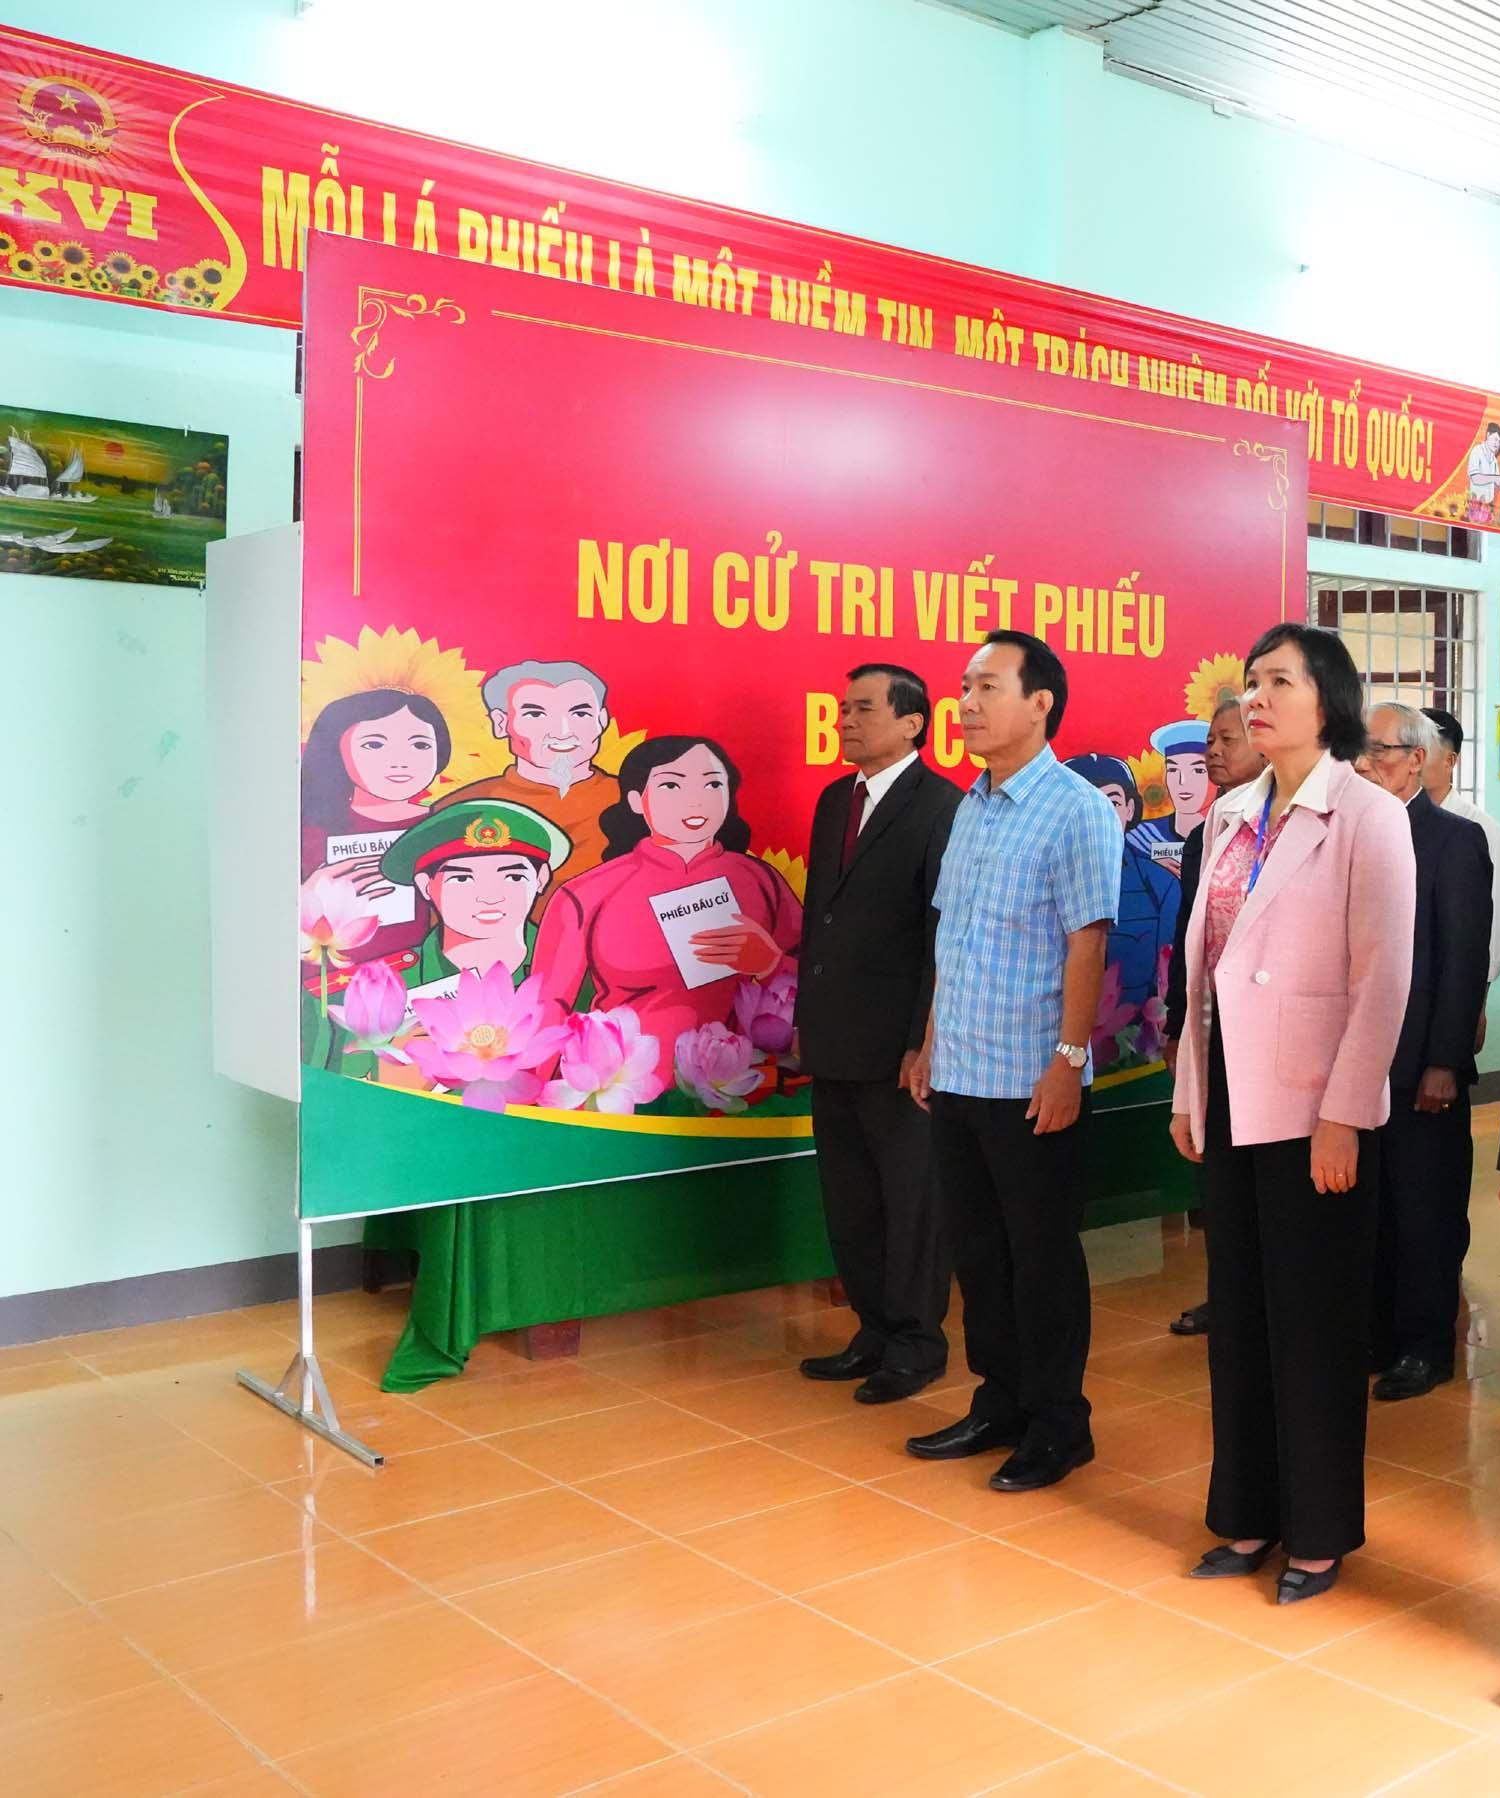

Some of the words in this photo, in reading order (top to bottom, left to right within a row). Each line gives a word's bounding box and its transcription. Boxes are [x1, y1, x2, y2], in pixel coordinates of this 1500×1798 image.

[1331, 379, 1361, 469] TỔ
[1366, 393, 1434, 484] QUỐC!
[577, 538, 689, 625] NƠI
[712, 530, 799, 632] CỬ
[809, 560, 894, 638] TRI
[912, 553, 1019, 644] VIẾT
[1033, 571, 1166, 659] PHIẾU
